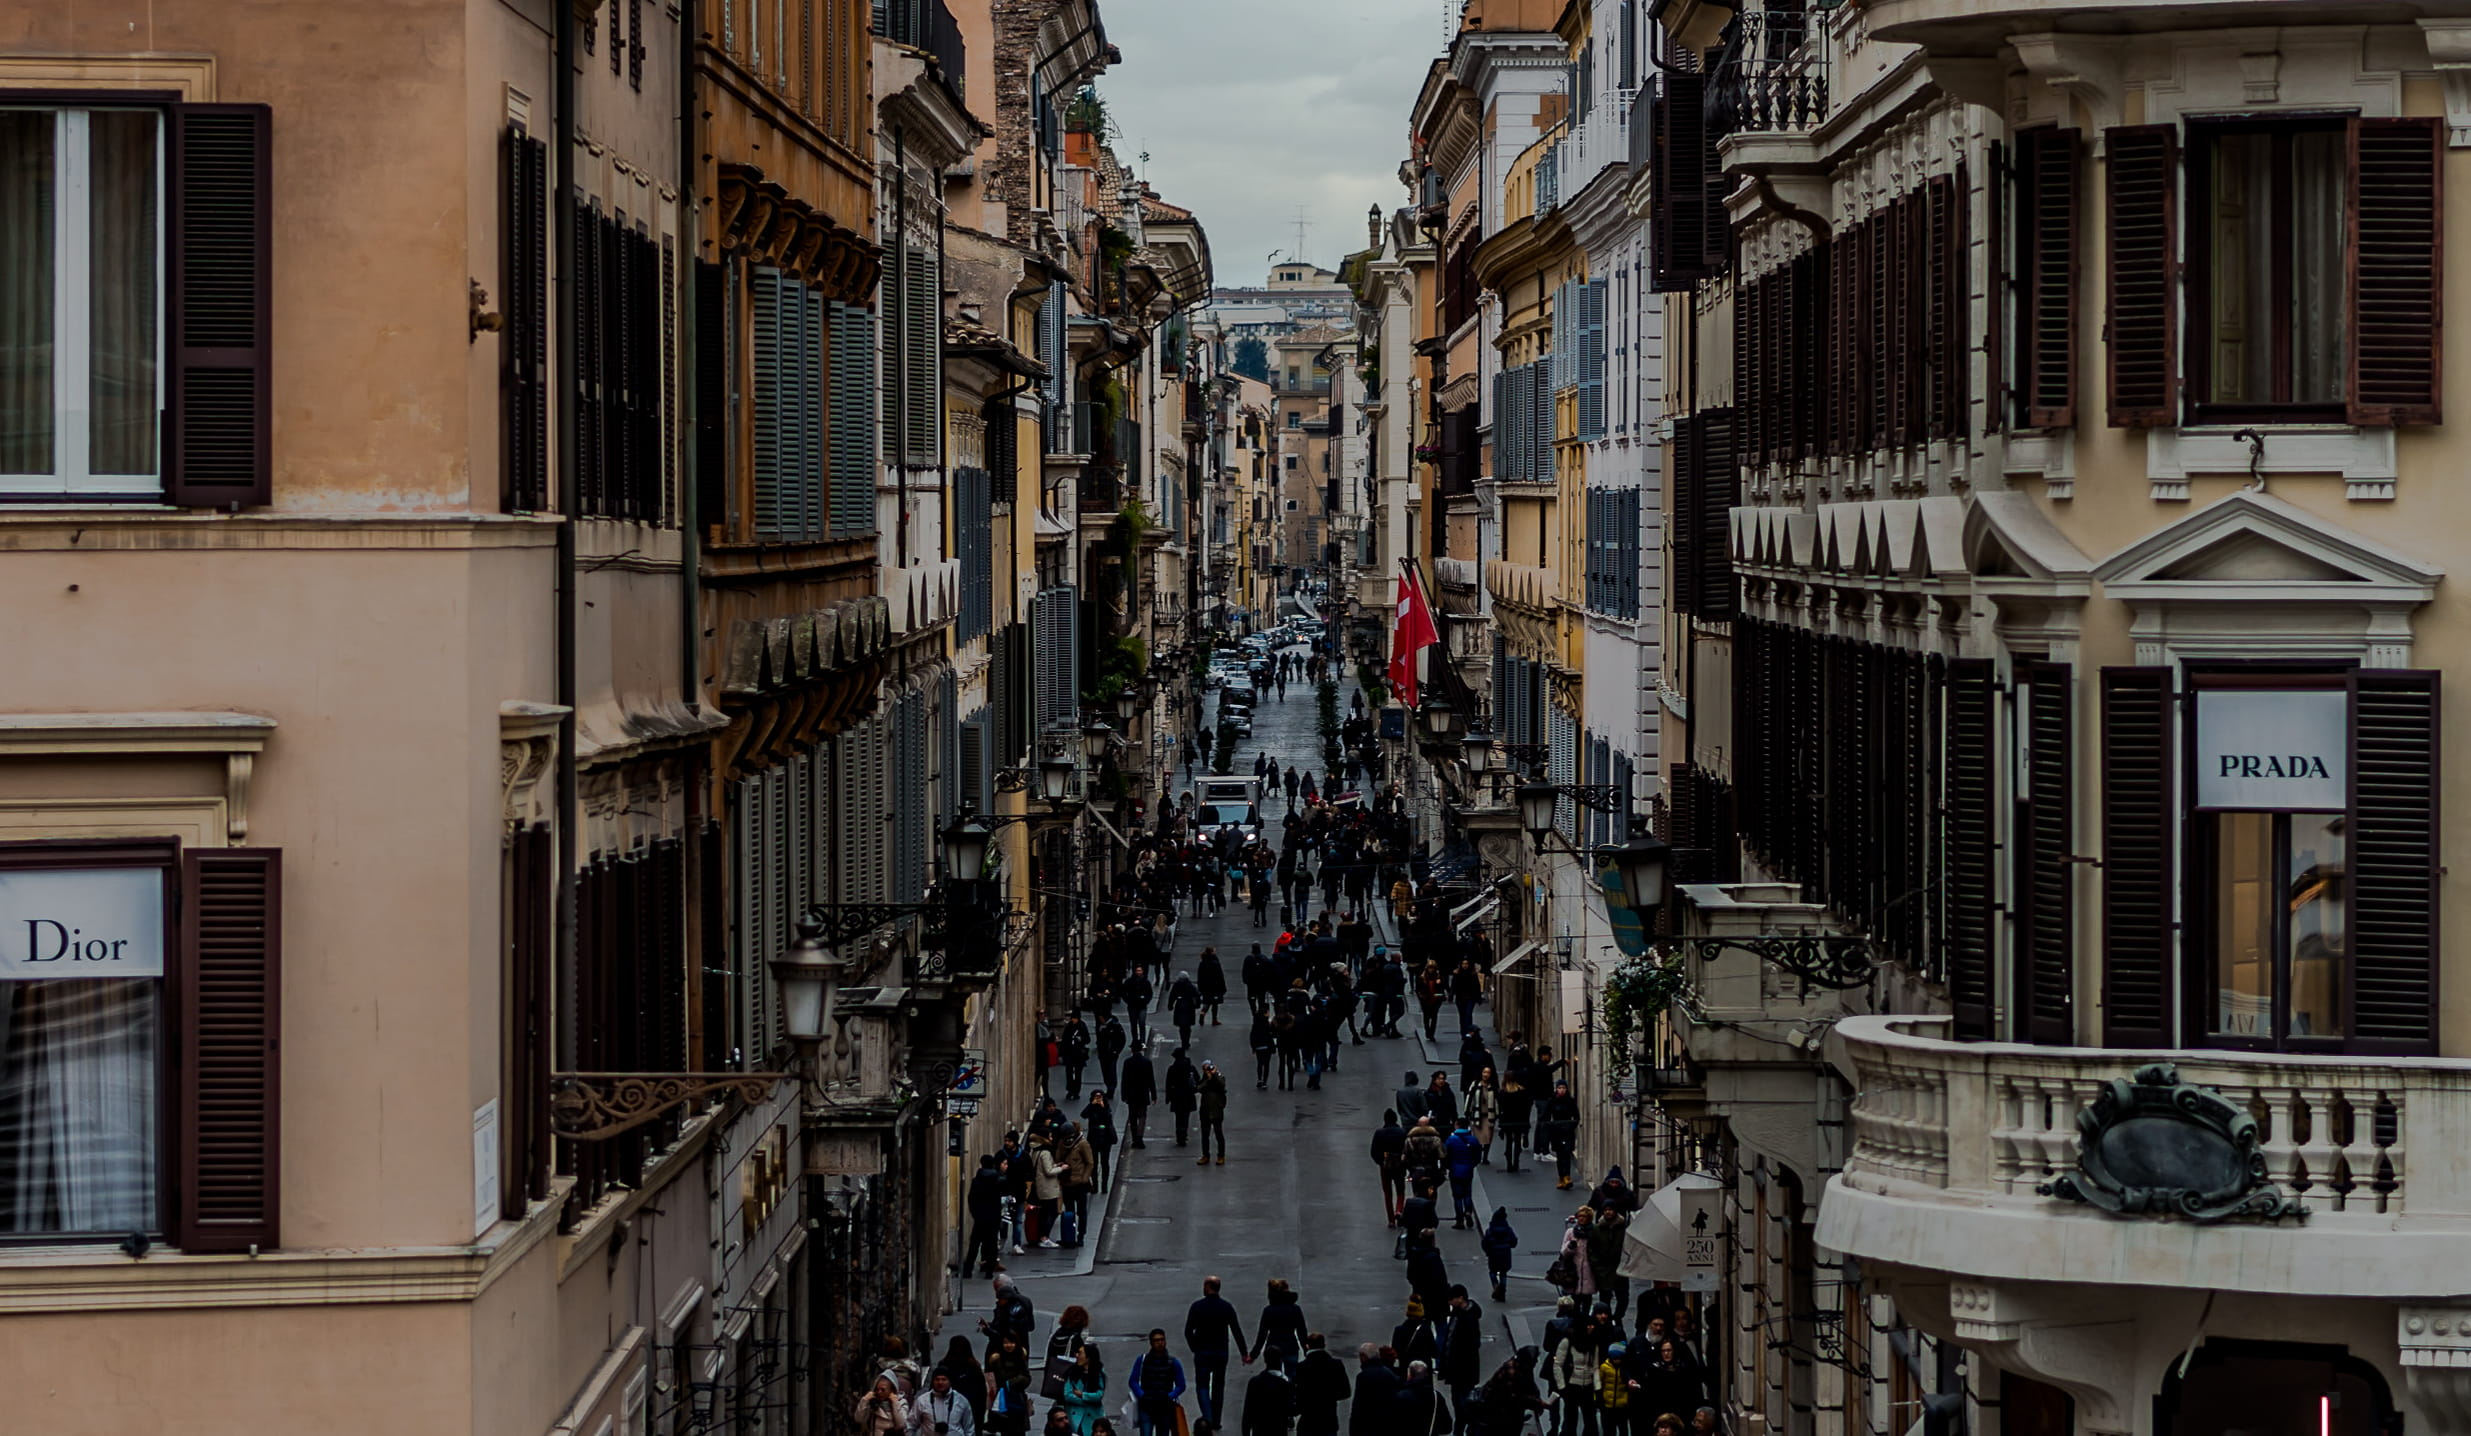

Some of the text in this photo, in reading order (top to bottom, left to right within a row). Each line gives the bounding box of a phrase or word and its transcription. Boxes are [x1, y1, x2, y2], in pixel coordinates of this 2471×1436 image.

[2219, 755, 2330, 779] PRADA
[22, 919, 128, 962] Dior
[1687, 1240, 1714, 1255] 250
